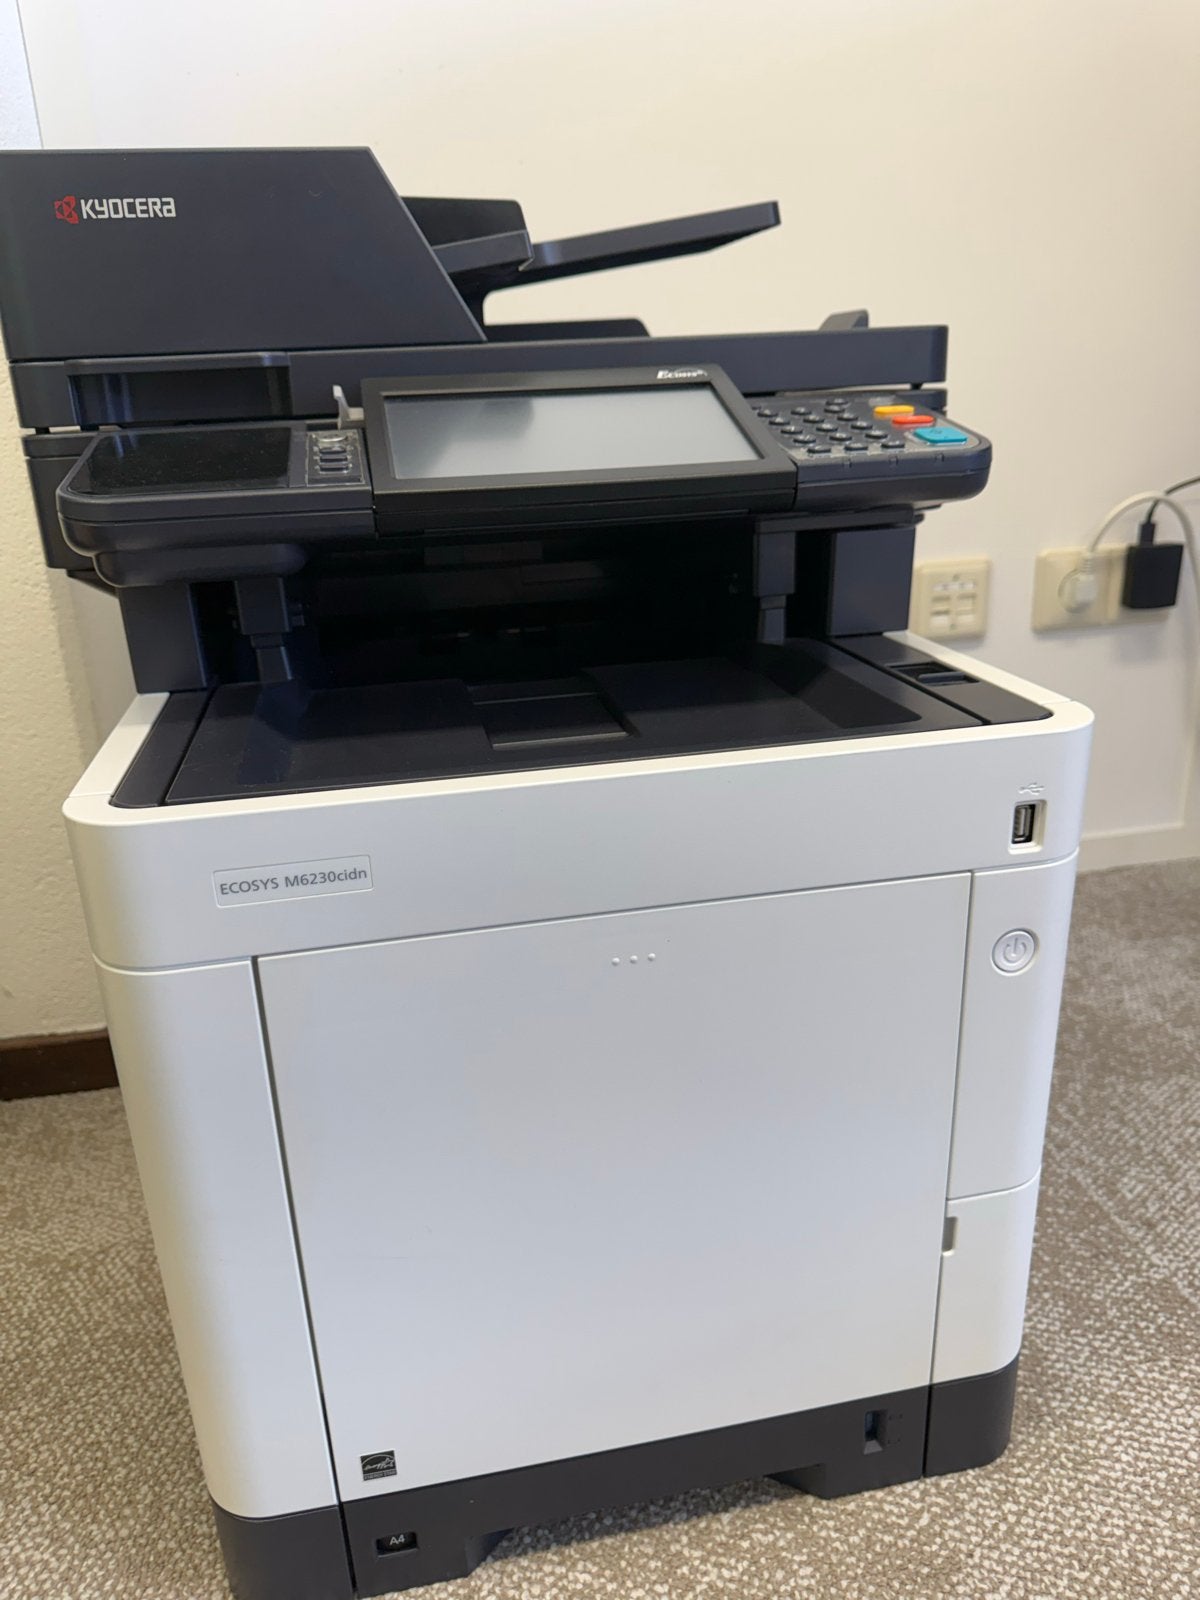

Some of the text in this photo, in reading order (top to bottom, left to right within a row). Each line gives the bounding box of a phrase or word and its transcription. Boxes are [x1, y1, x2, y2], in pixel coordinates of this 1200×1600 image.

[80, 197, 177, 220] KYOCERA
[219, 867, 368, 896] ECOSYS M6230cidn
[389, 1534, 405, 1546] A4
